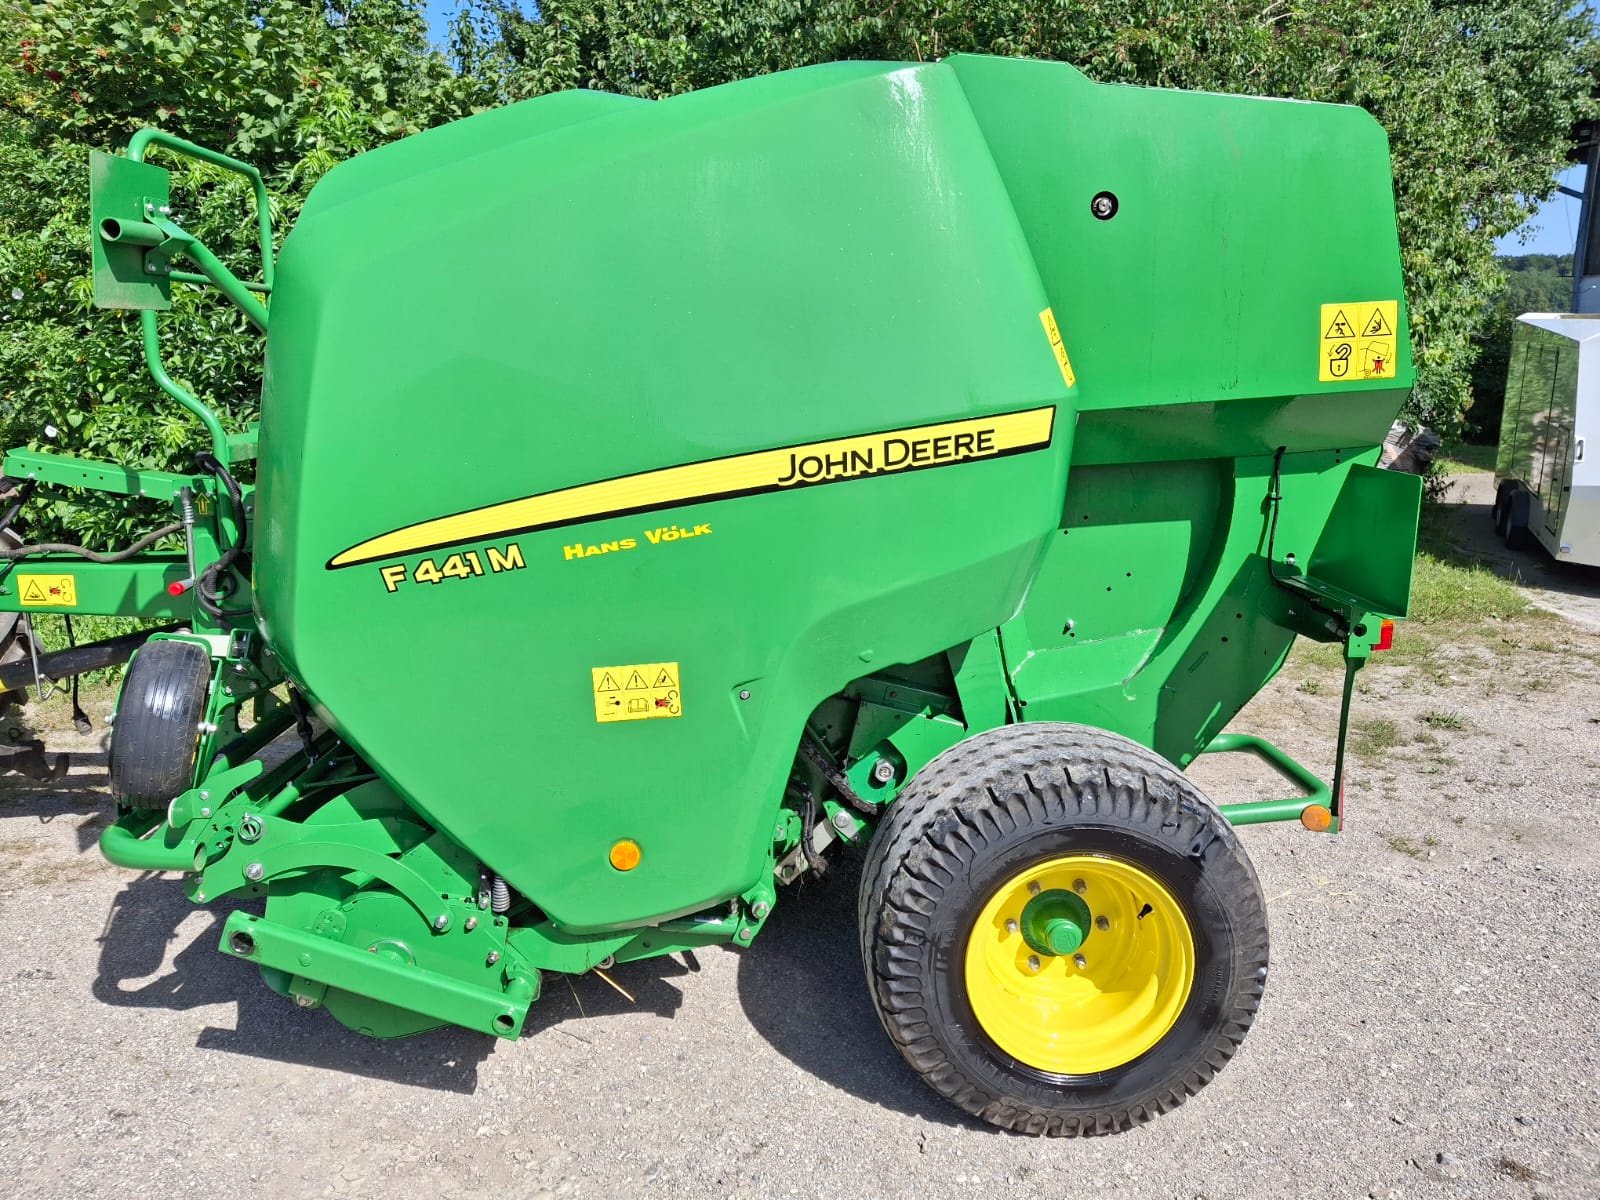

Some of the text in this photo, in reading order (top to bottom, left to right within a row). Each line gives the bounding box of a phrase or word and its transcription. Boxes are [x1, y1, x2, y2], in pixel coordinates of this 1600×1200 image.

[778, 429, 995, 483] JOHN DEERE
[563, 523, 713, 560] HANS VÖLK
[379, 543, 527, 593] F 441 M
